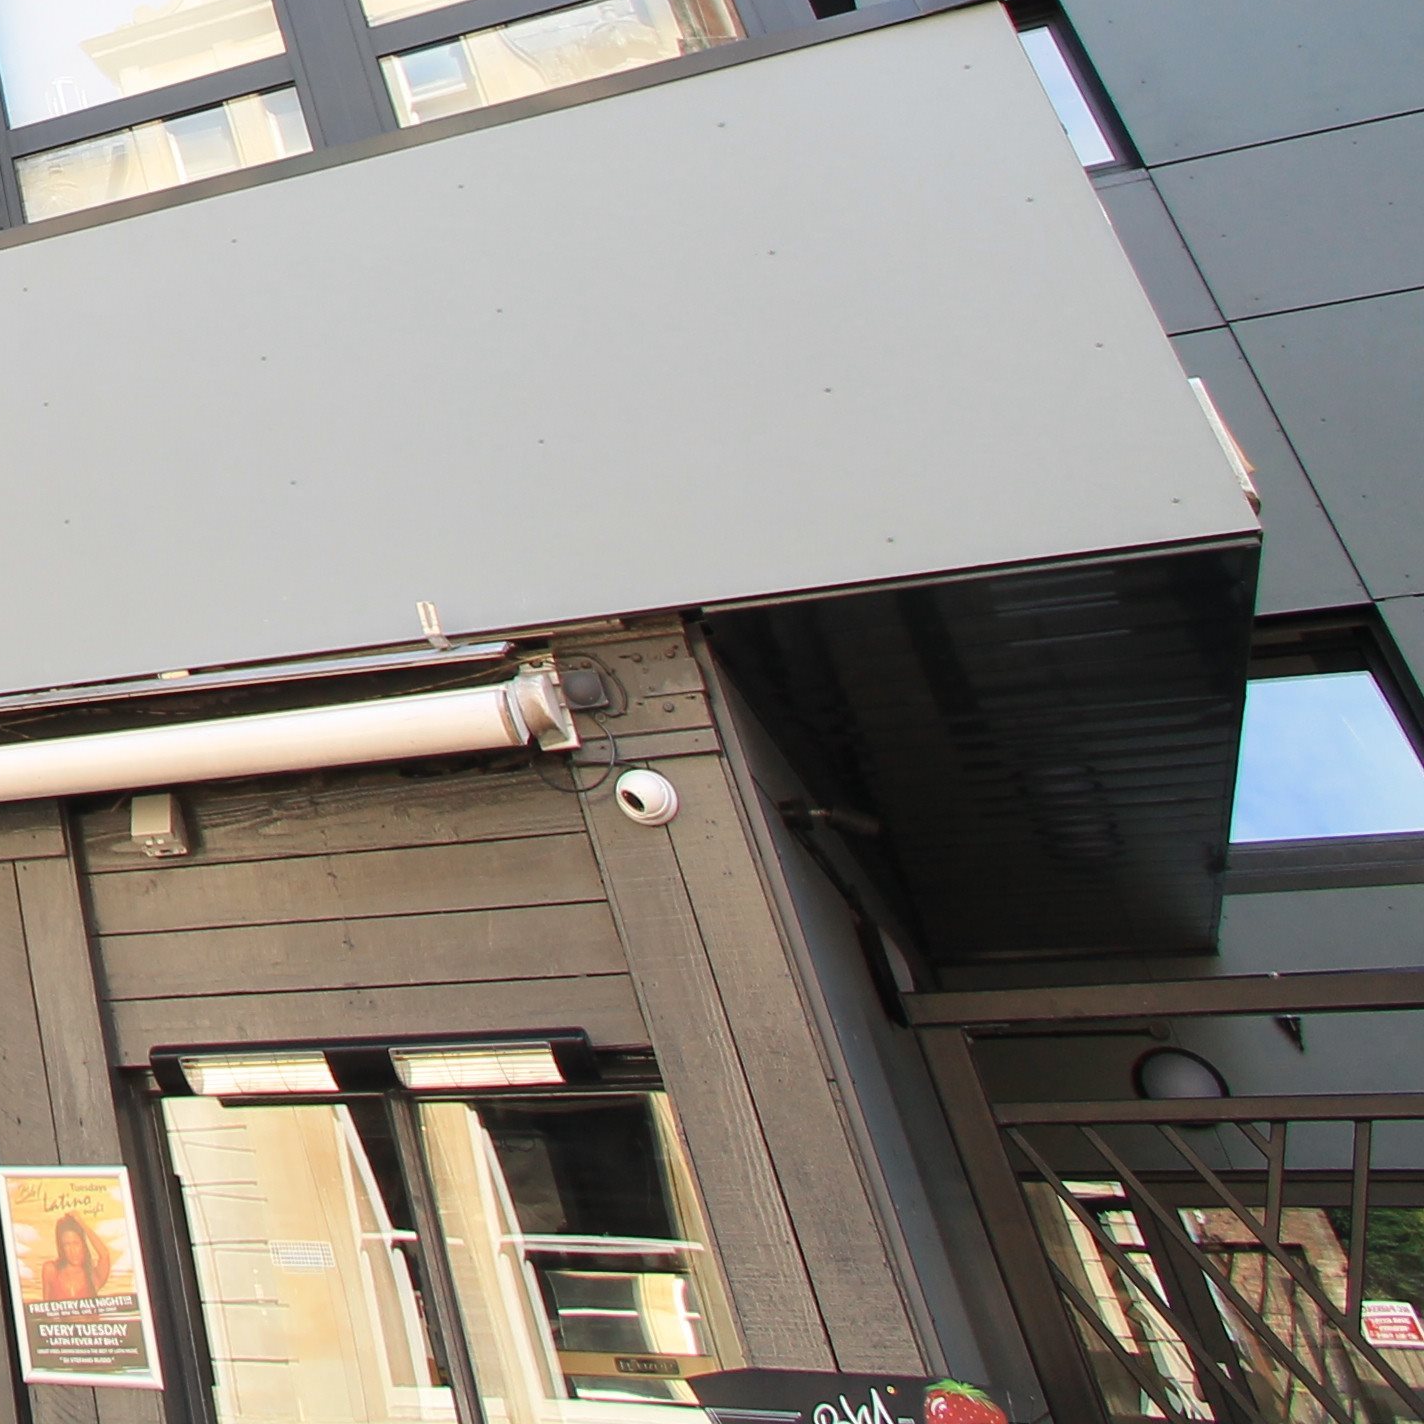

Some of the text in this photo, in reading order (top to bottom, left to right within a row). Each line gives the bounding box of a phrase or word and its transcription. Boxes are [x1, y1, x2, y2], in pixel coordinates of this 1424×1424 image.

[69, 1182, 107, 1192] Tuesdays
[42, 1192, 91, 1212] Latino
[29, 1302, 50, 1313] FREE
[52, 1300, 80, 1311] ENTRY
[80, 1298, 95, 1309] ALL
[39, 1323, 127, 1336] EVERY TUESDAY
